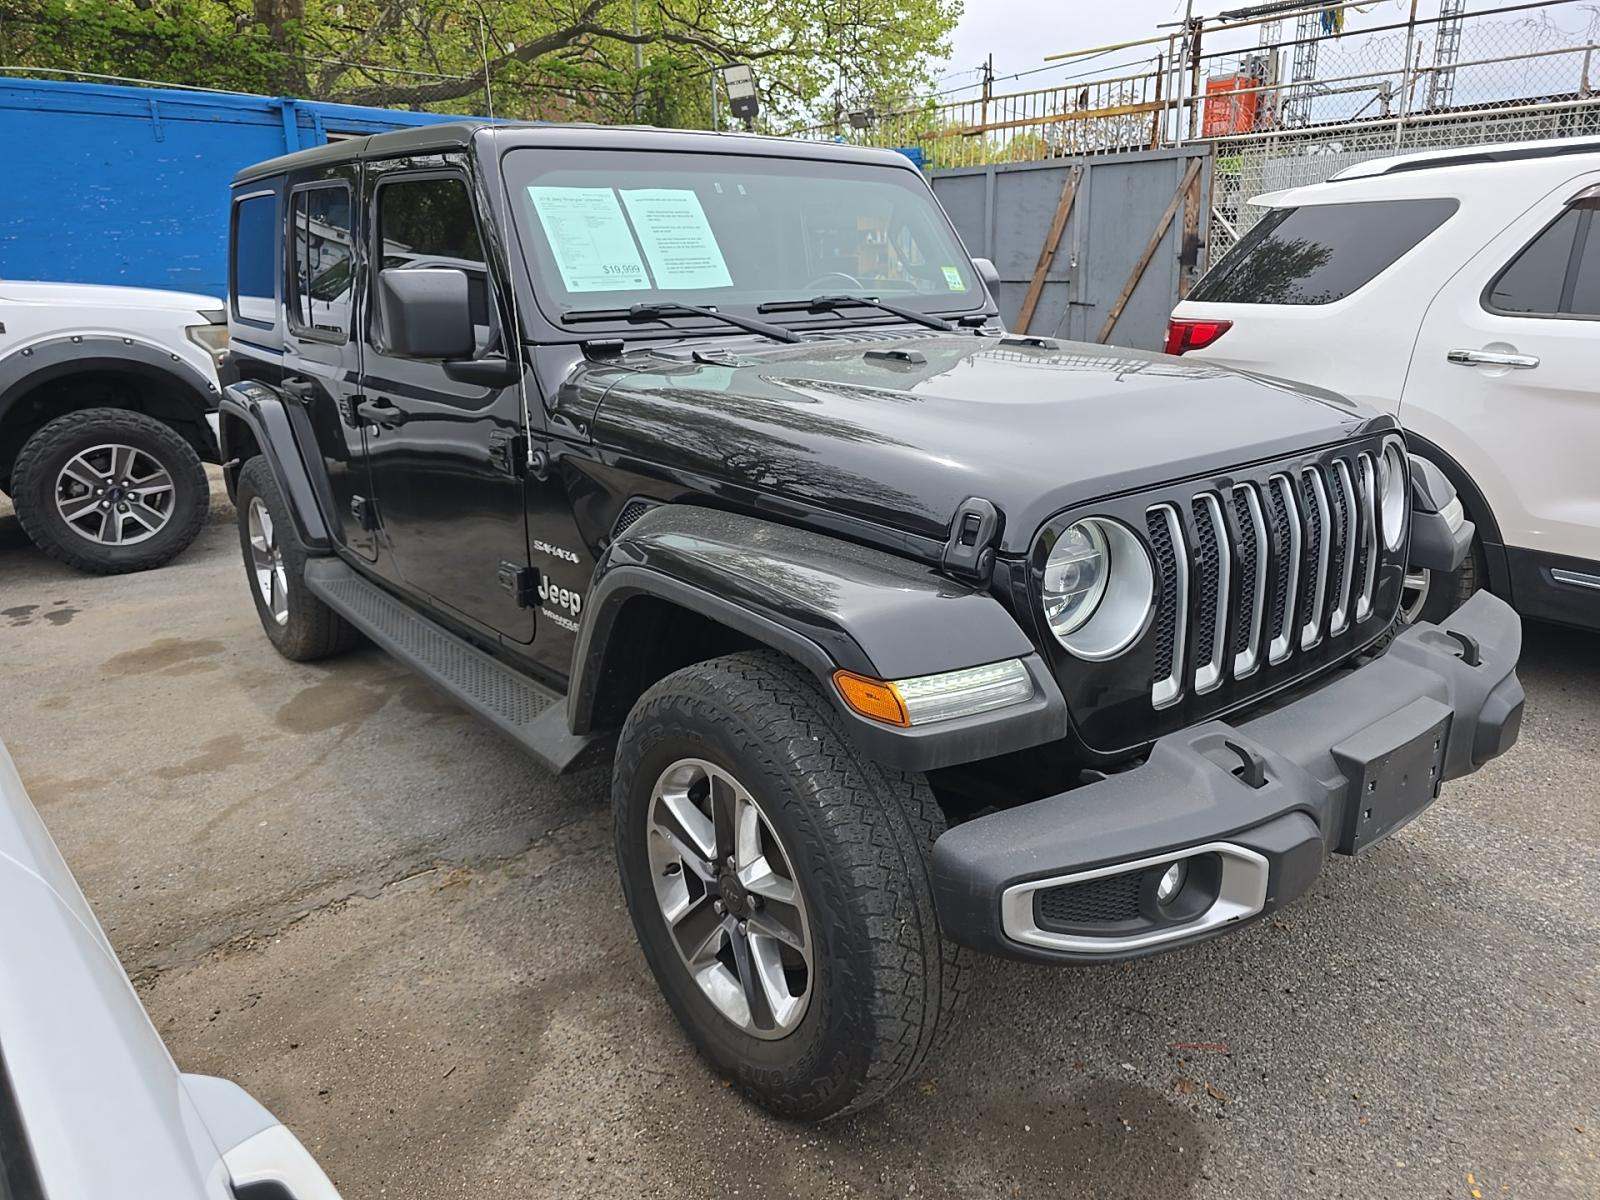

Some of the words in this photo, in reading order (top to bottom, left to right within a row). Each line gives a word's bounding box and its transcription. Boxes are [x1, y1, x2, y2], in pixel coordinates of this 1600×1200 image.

[602, 263, 641, 276] $19,999
[533, 540, 580, 564] SAHARA
[537, 575, 581, 616] Jeep
